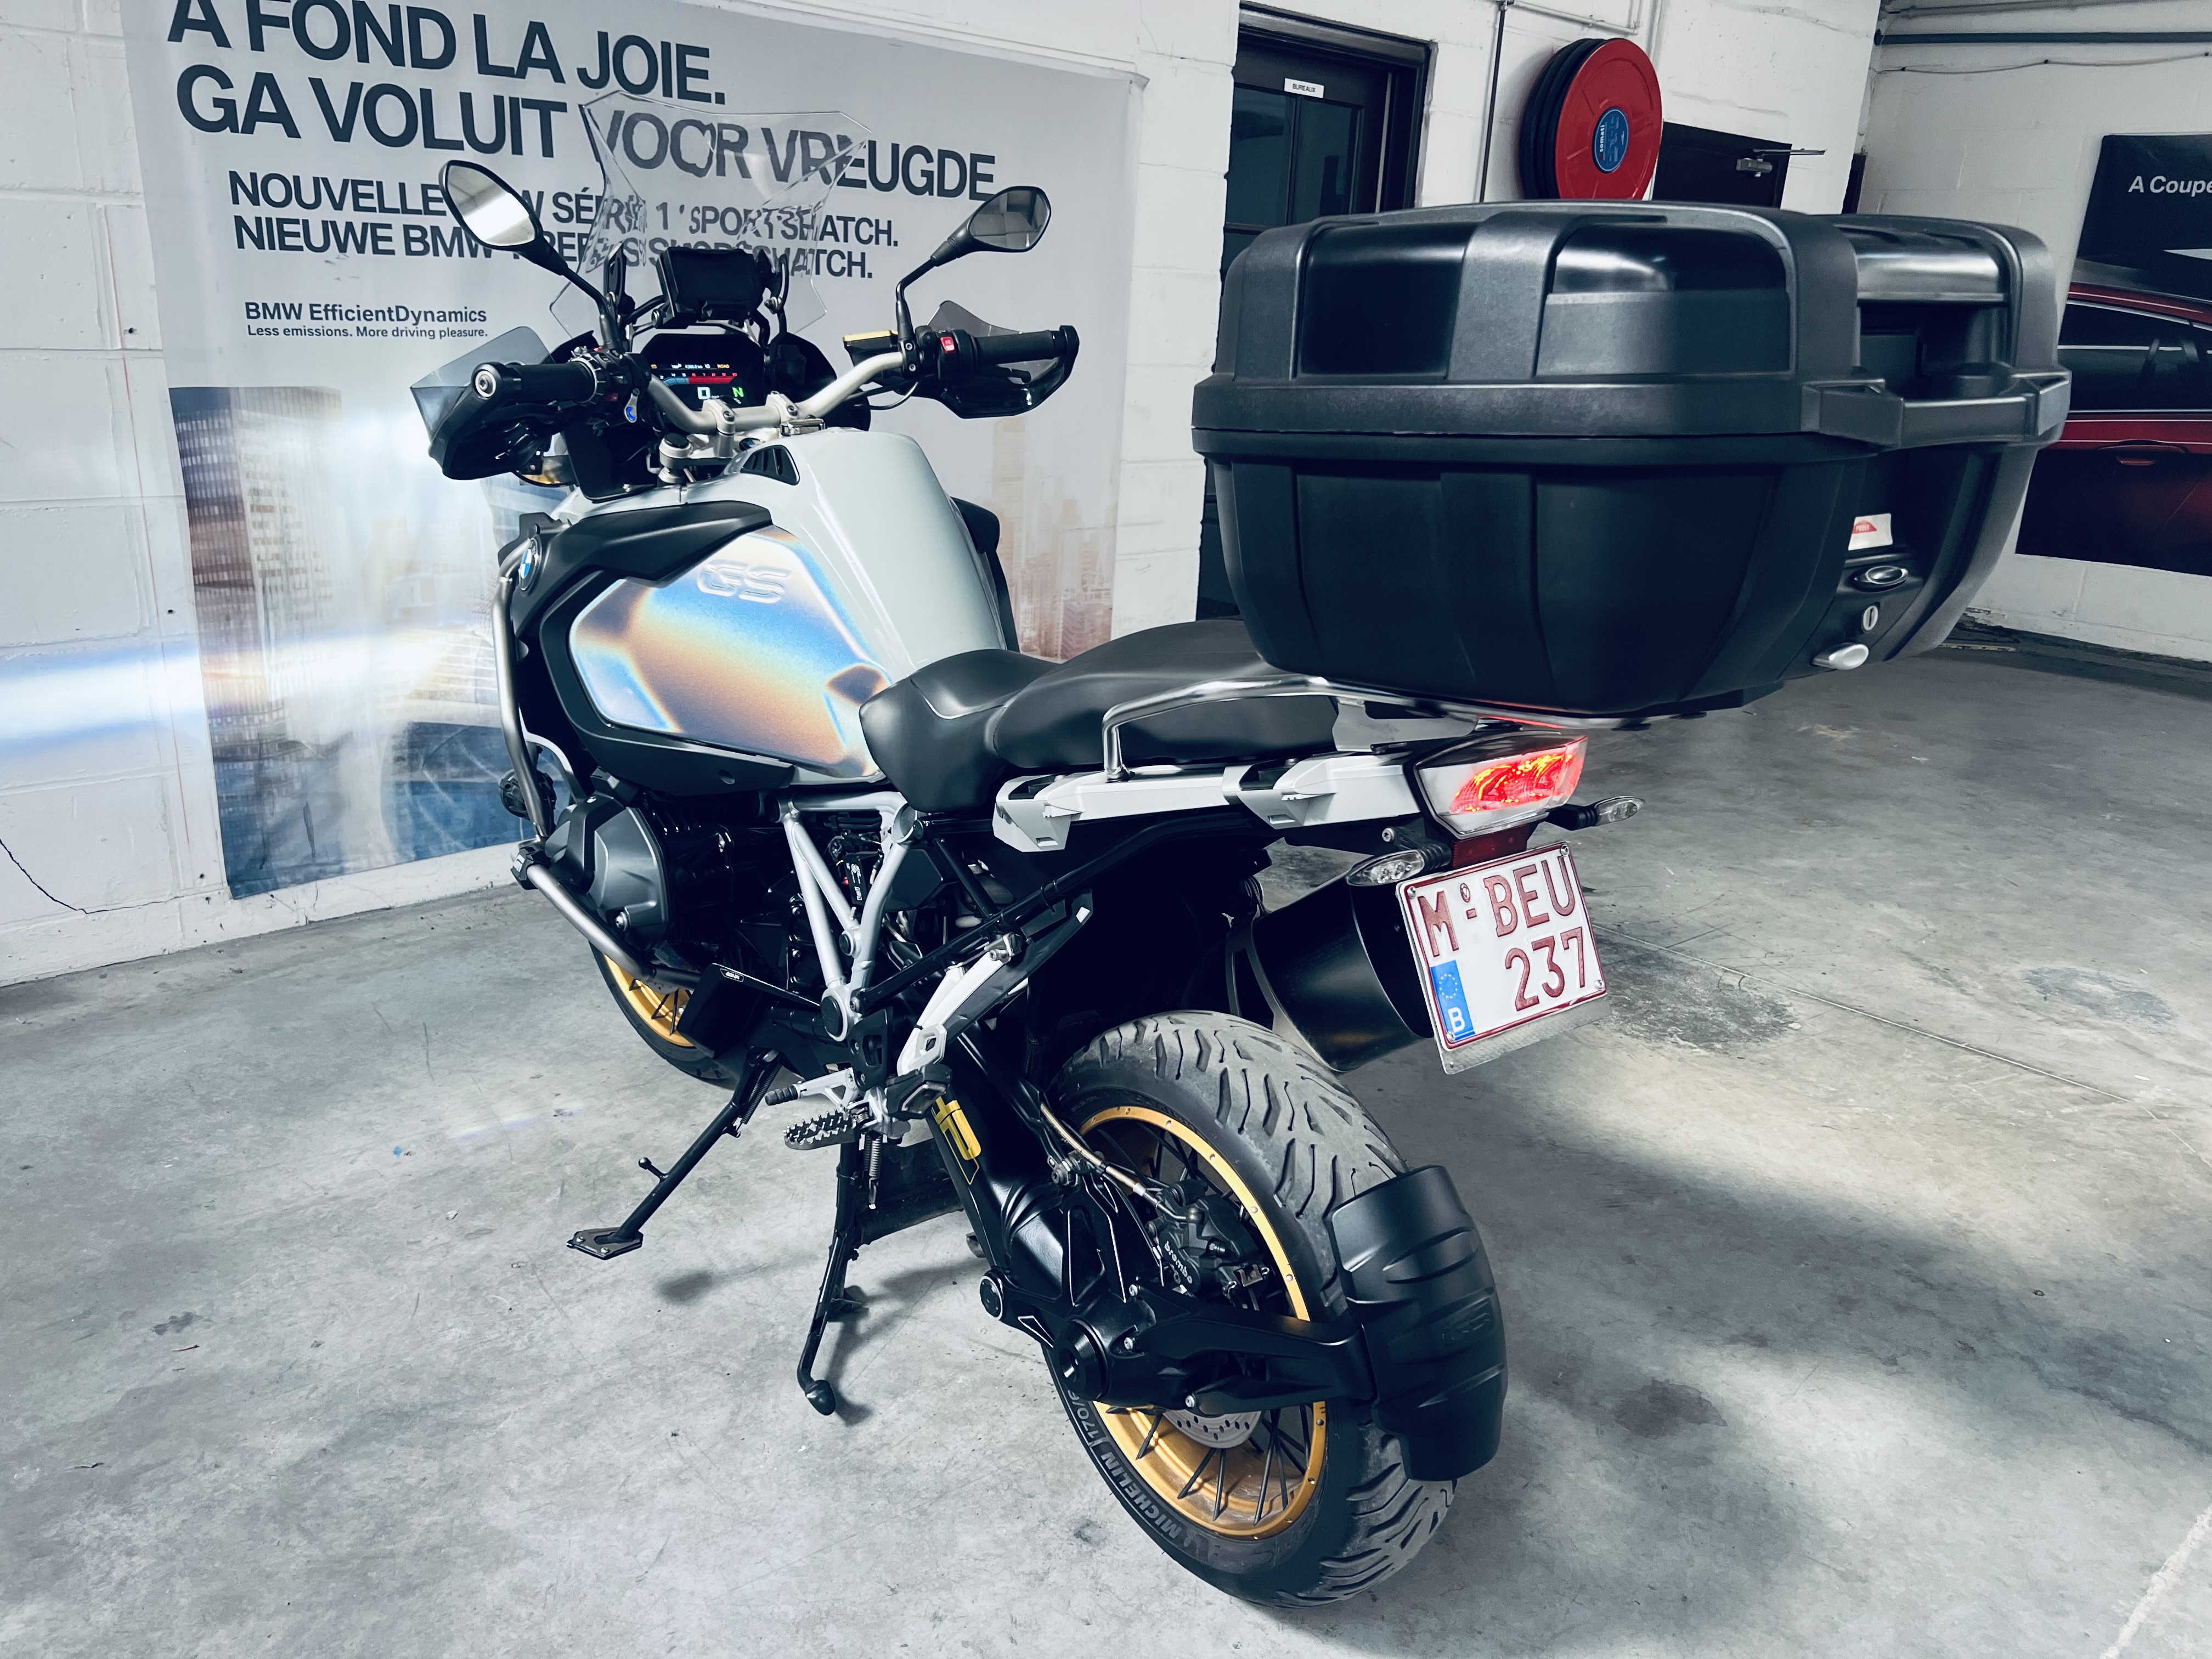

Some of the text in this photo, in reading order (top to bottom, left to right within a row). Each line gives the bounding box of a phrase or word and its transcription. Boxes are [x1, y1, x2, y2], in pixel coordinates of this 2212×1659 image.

[168, 0, 725, 105] A FOND LA JOIE.
[1292, 83, 1316, 93] BUREAUX
[177, 64, 302, 139] GA
[308, 77, 567, 158] VOLUIT
[761, 127, 996, 201] VREUGDE
[229, 171, 447, 216] NOUVELLE
[2128, 176, 2145, 193] A
[234, 215, 396, 256] NIEUWE
[245, 302, 487, 326] BMW EfficientDynamics
[247, 325, 488, 340] Less emissions. More driving pleasure.
[732, 387, 744, 397] N
[698, 559, 792, 604] GS
[1505, 927, 1585, 1012] 237
[1449, 1007, 1465, 1033] B
[1164, 1240, 1193, 1284] brembo
[1101, 1452, 1182, 1539] MICHELIN
